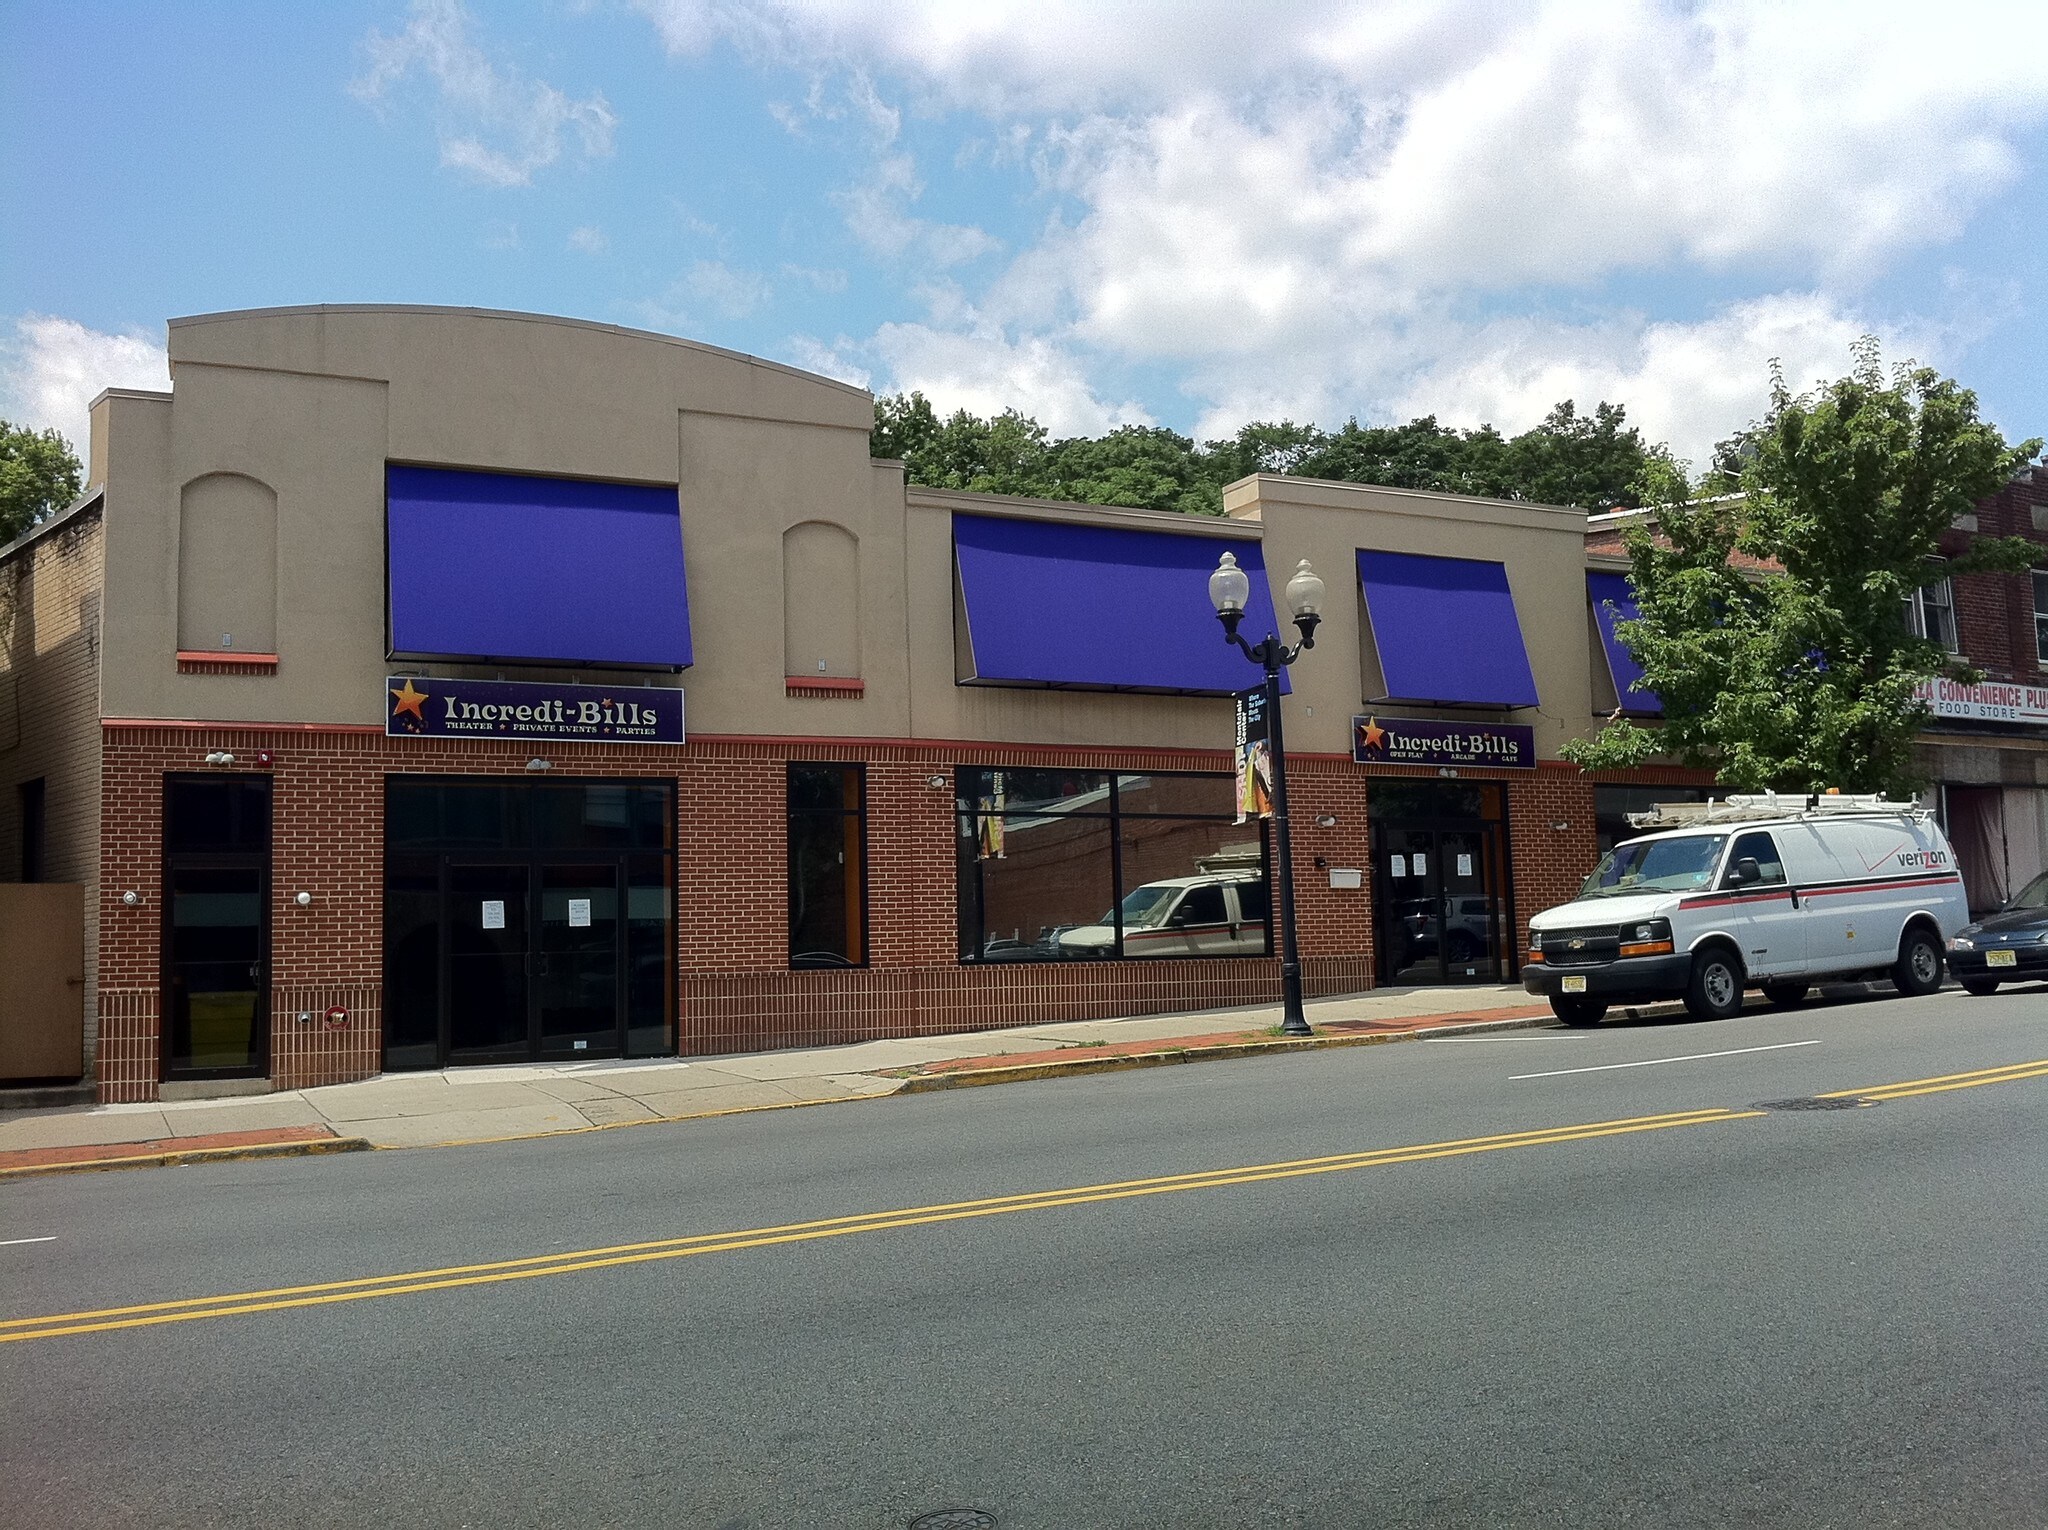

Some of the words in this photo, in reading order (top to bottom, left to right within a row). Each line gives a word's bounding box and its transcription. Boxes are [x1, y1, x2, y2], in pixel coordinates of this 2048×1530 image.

[1939, 681, 2021, 707] CONVENIENCE
[2027, 689, 2048, 709] PLU
[444, 696, 657, 725] Incredi-Bills
[1939, 702, 1970, 715] FOOD
[1980, 705, 2016, 719] STORE
[445, 721, 493, 730] THEATER
[513, 723, 556, 732] PRIVATE
[559, 725, 597, 733] EVENTS
[616, 727, 656, 735] PARTIES
[1387, 732, 1518, 754] Incredi-Bills
[1897, 848, 1946, 869] verizon
